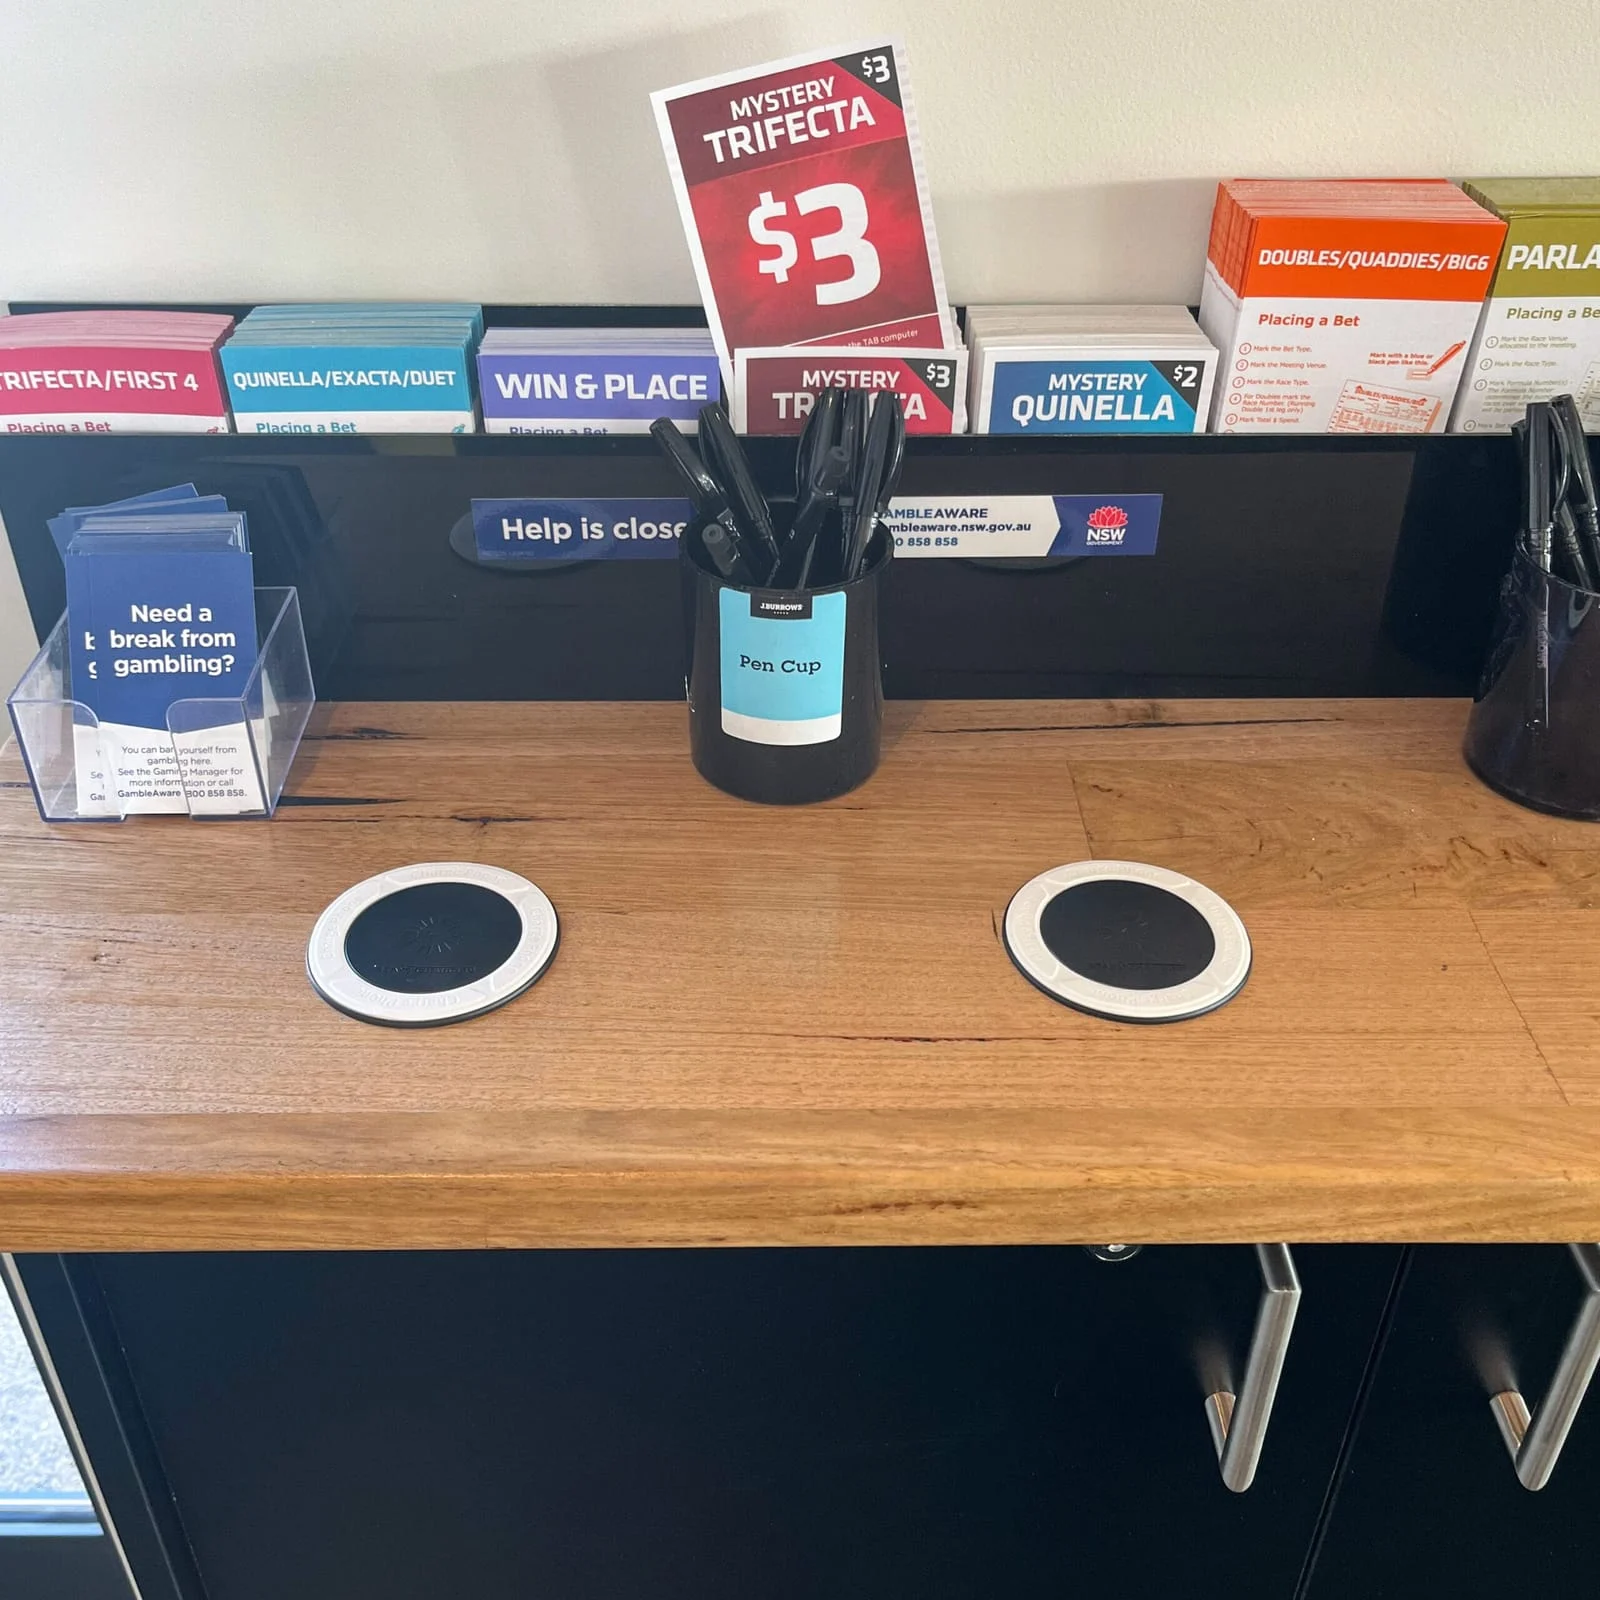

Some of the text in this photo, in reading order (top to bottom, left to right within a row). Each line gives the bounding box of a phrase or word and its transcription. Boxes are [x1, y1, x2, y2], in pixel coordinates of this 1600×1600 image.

[862, 55, 891, 83] $3
[729, 76, 835, 121] MYSTERY
[703, 95, 876, 163] TRIFECTA
[748, 182, 882, 306] $3
[1258, 249, 1490, 271] DOUBLES/QUADDIES/BIG6
[1506, 244, 1600, 270] PARLA
[1258, 314, 1360, 328] Placing a Bet
[1506, 307, 1600, 321] Placing a Be
[863, 336, 880, 346] TAB
[880, 330, 918, 343] computer
[184, 374, 199, 391] 4
[233, 370, 456, 390] QUINELLA/EXACTA/DUET
[802, 369, 901, 388] MYSTERY
[926, 362, 951, 388] $3
[1048, 373, 1148, 391] MYSTERY
[1173, 364, 1198, 388] $2
[494, 373, 708, 400] WIN & PLACE
[1012, 394, 1175, 427] QUINELLA
[7, 422, 65, 433] Placing
[84, 421, 111, 433] Bet
[256, 421, 357, 433] Placing a Bet
[884, 508, 988, 519] AMBLEAWARE
[502, 517, 572, 544] Help
[580, 517, 604, 539] is
[889, 523, 1031, 533] mbleaware.nsw.gov.au
[1087, 528, 1126, 541] NSW
[908, 537, 931, 546] 858
[935, 537, 958, 546] 858
[131, 604, 212, 623] Need a
[110, 629, 176, 649] break
[181, 629, 236, 647] from
[114, 654, 235, 677] gambling?
[739, 654, 821, 675] Pen Cup
[121, 745, 139, 754] You
[140, 746, 157, 754] can
[178, 746, 213, 756] yourself
[215, 745, 237, 754] from
[191, 757, 212, 765] here.
[90, 771, 104, 780] Se
[118, 768, 135, 776] See
[136, 768, 151, 776] the
[190, 768, 228, 777] Manager
[230, 766, 243, 775] for
[129, 779, 153, 787] more
[207, 779, 217, 787] or
[218, 778, 234, 787] call
[118, 789, 182, 798] GambleAware
[207, 789, 225, 798] 858
[227, 789, 248, 797] 858.
